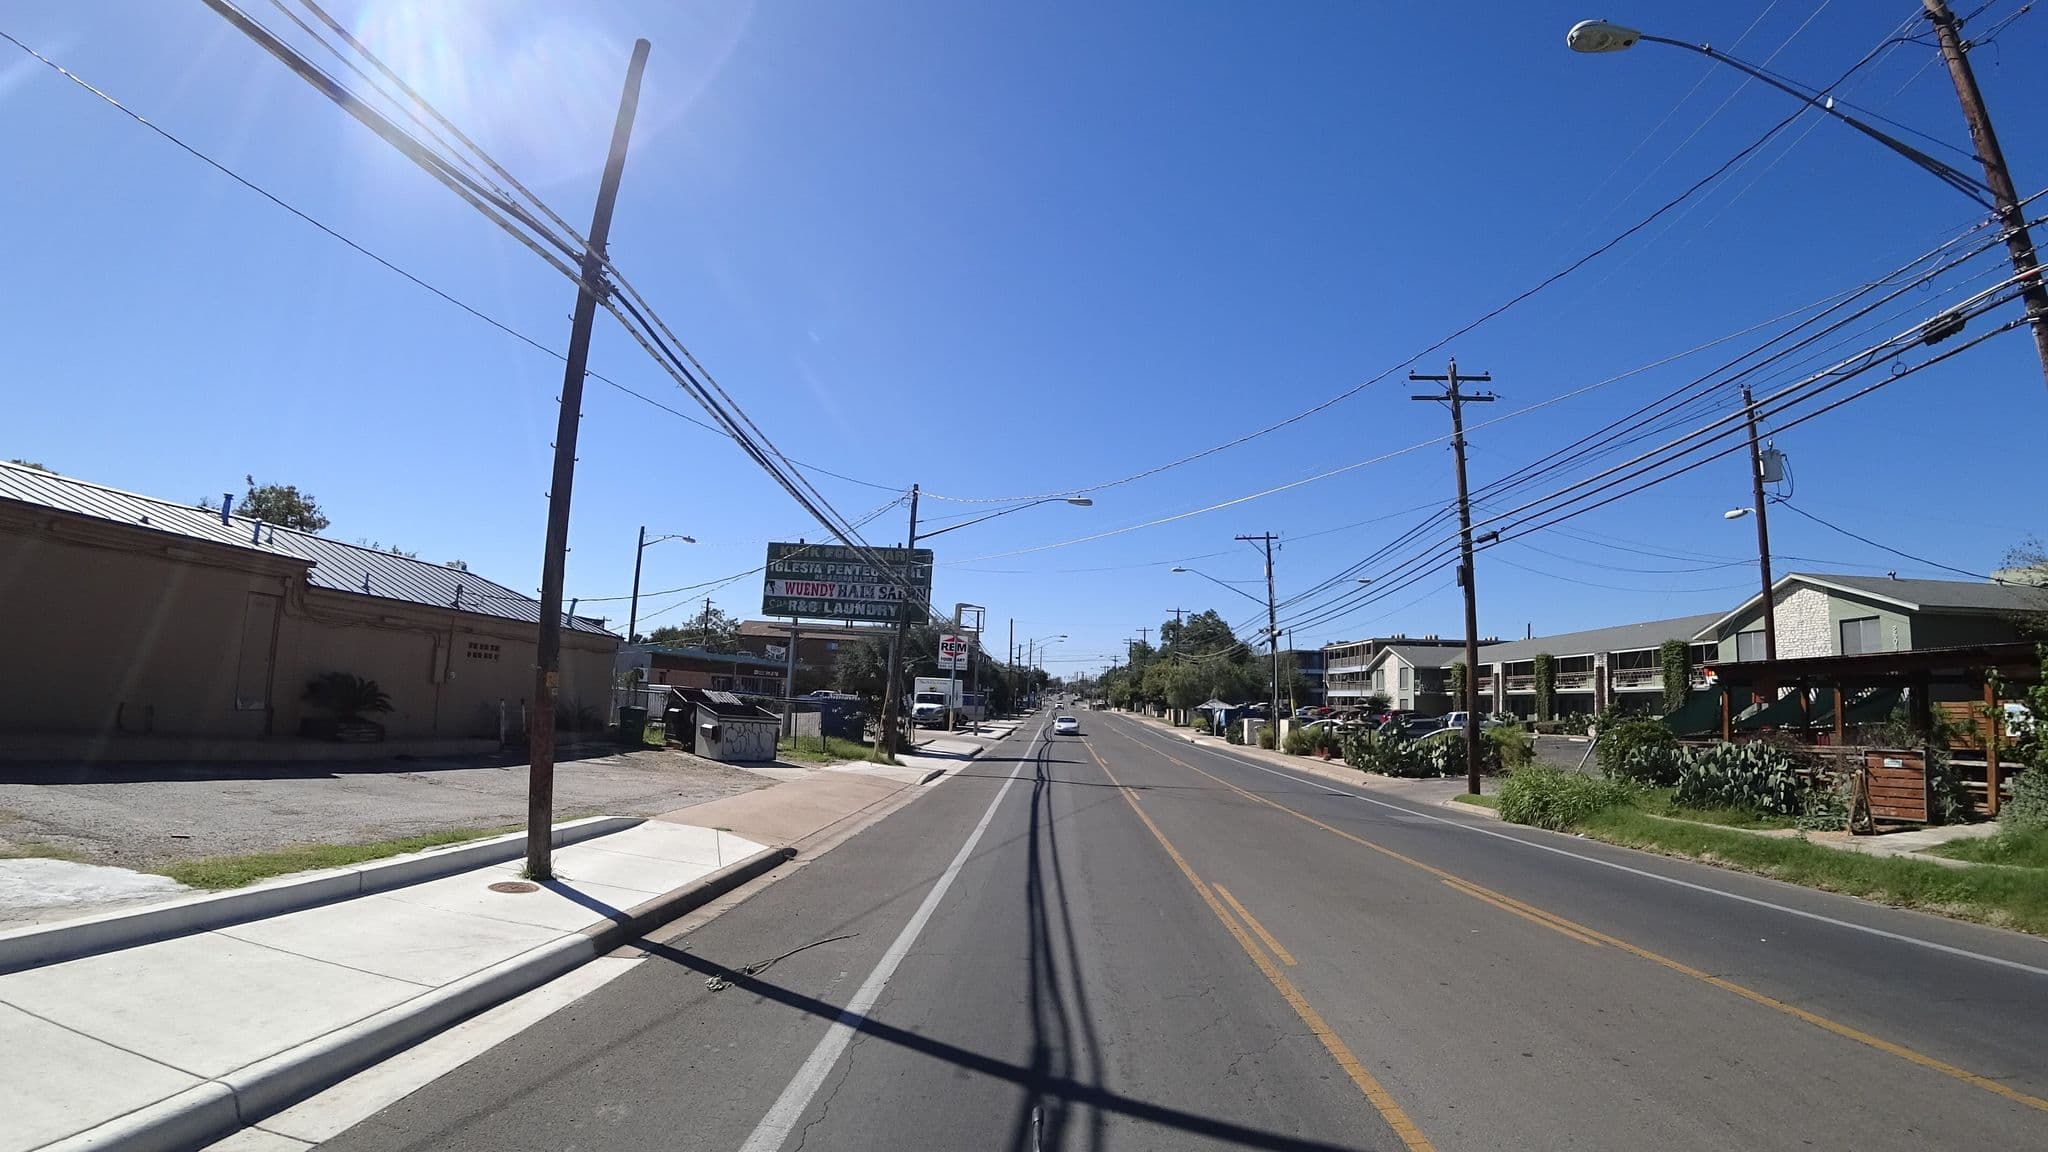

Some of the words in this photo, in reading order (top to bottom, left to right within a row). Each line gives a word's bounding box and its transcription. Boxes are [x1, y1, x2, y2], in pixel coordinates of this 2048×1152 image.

[785, 582, 836, 597] WUENDY
[837, 584, 875, 599] HAIR
[878, 586, 927, 603] SALN
[823, 602, 897, 617] LAUNDRY
[941, 642, 966, 653] REM
